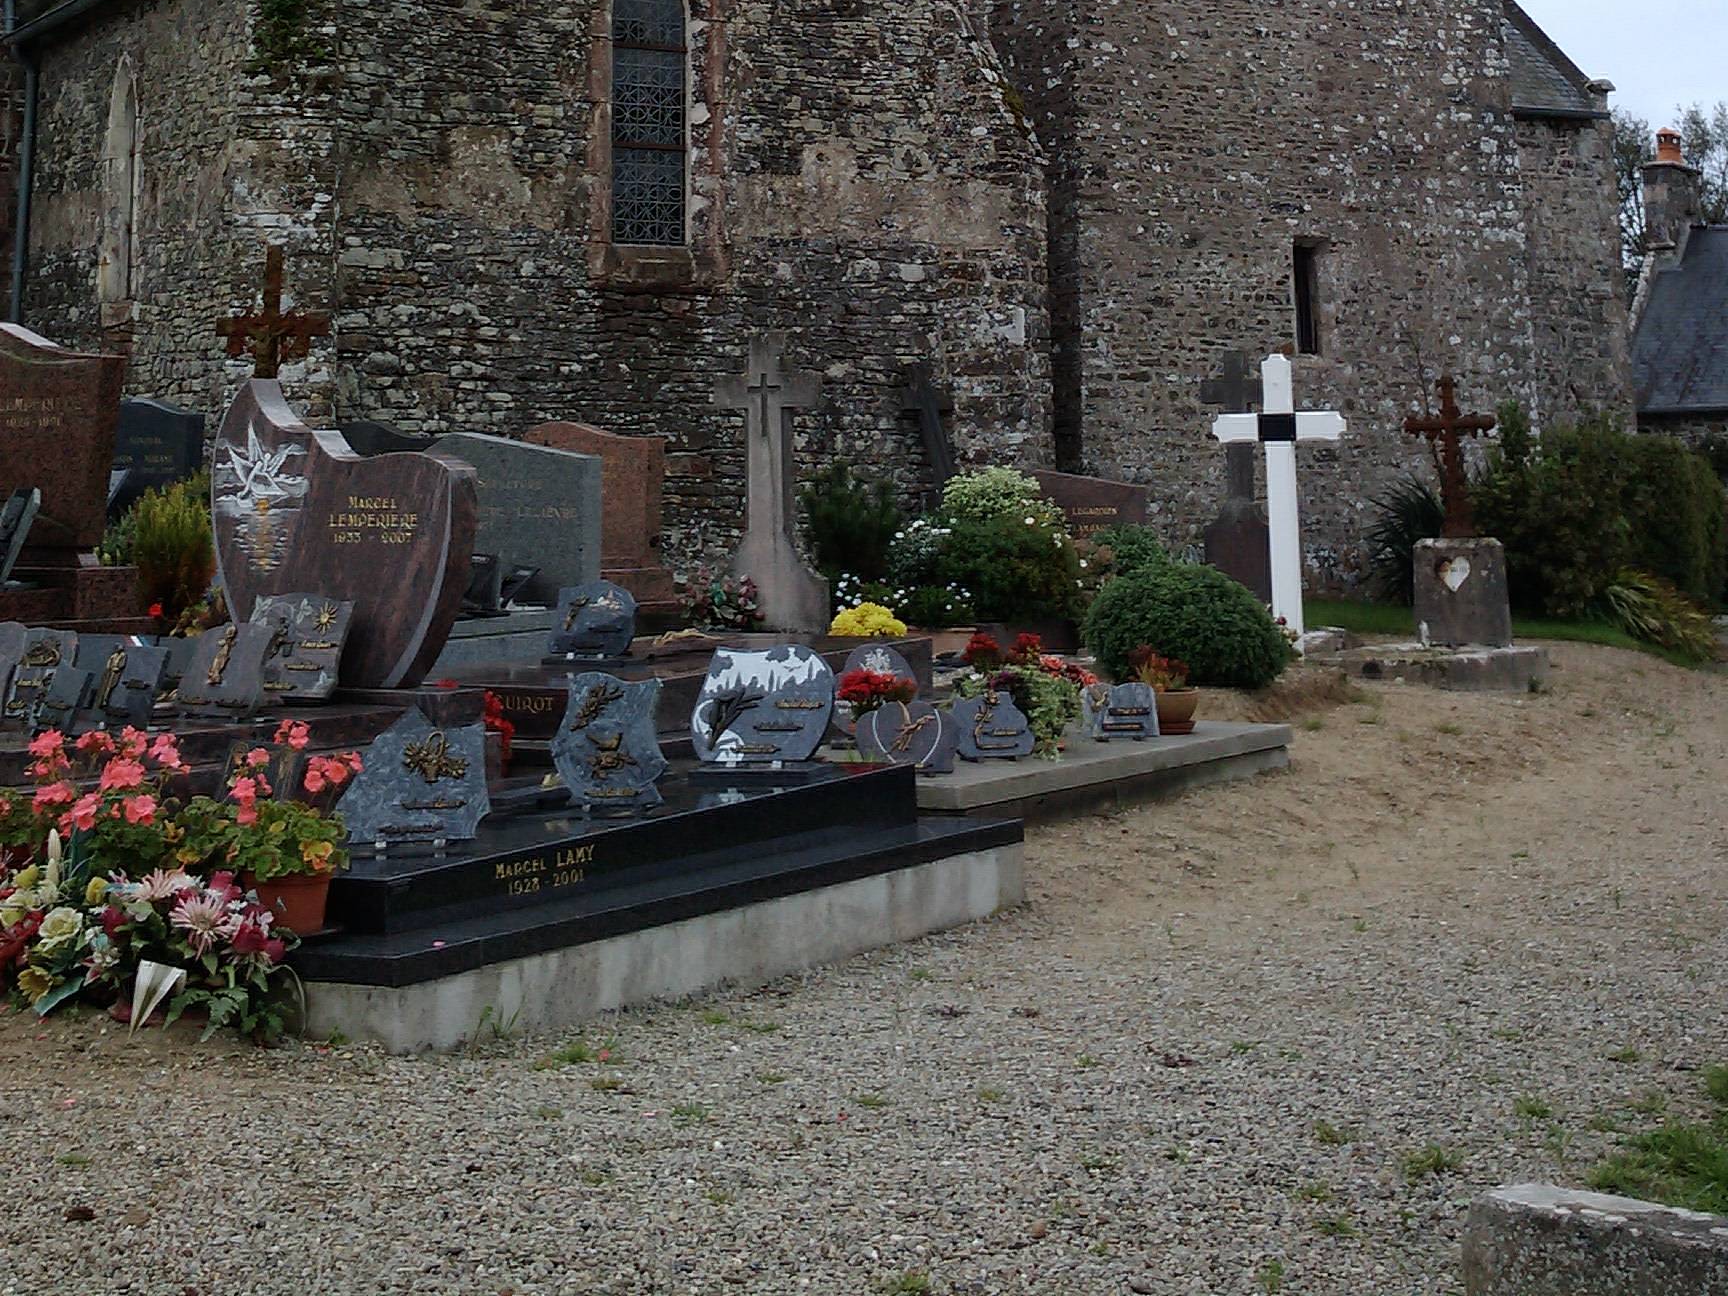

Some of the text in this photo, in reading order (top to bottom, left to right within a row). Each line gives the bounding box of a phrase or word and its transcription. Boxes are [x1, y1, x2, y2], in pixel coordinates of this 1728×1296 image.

[348, 495, 397, 509] MARCEL
[328, 512, 418, 530] LEMPERIERE
[495, 844, 595, 879] MARCEL LAMY
